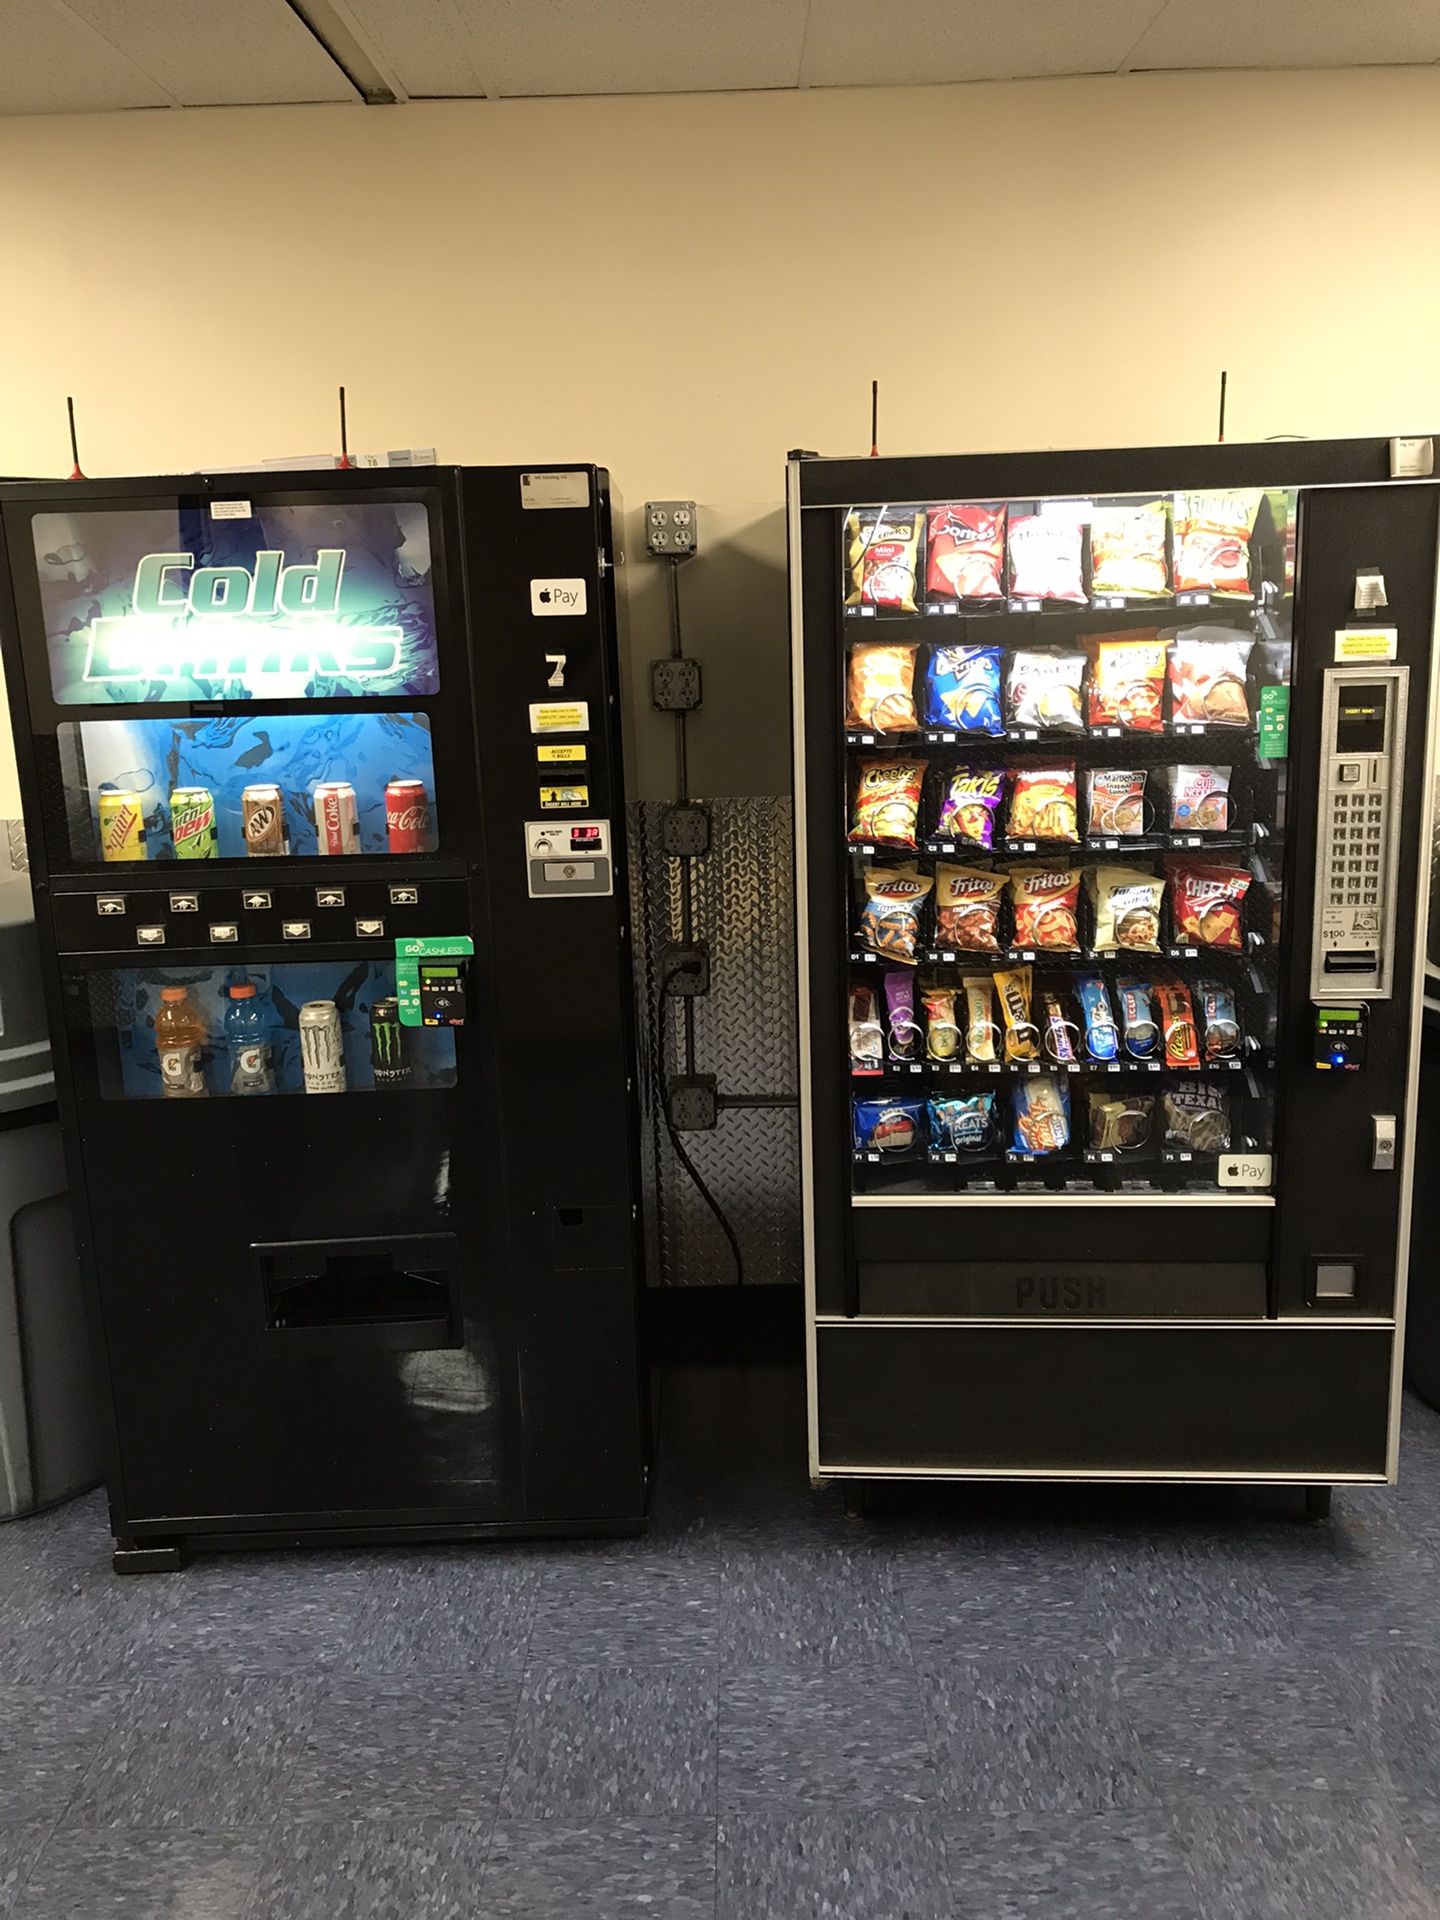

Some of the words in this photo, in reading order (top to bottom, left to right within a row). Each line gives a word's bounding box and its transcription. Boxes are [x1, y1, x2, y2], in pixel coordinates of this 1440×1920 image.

[132, 549, 346, 618] Cold
[554, 588, 579, 607] Pay
[864, 765, 918, 788] Cheetos
[952, 772, 1000, 796] Takis
[326, 797, 339, 831] Coke
[876, 879, 921, 894] Fritos
[950, 877, 994, 896] Fritos
[1023, 872, 1071, 894] Fritos
[405, 944, 420, 953] GO
[419, 946, 464, 955] CASHLESS
[162, 1053, 182, 1076] G
[240, 1048, 261, 1073] G
[954, 1117, 988, 1131] REATS
[1241, 1164, 1266, 1179] Pay
[1016, 1278, 1106, 1310] PUSH
